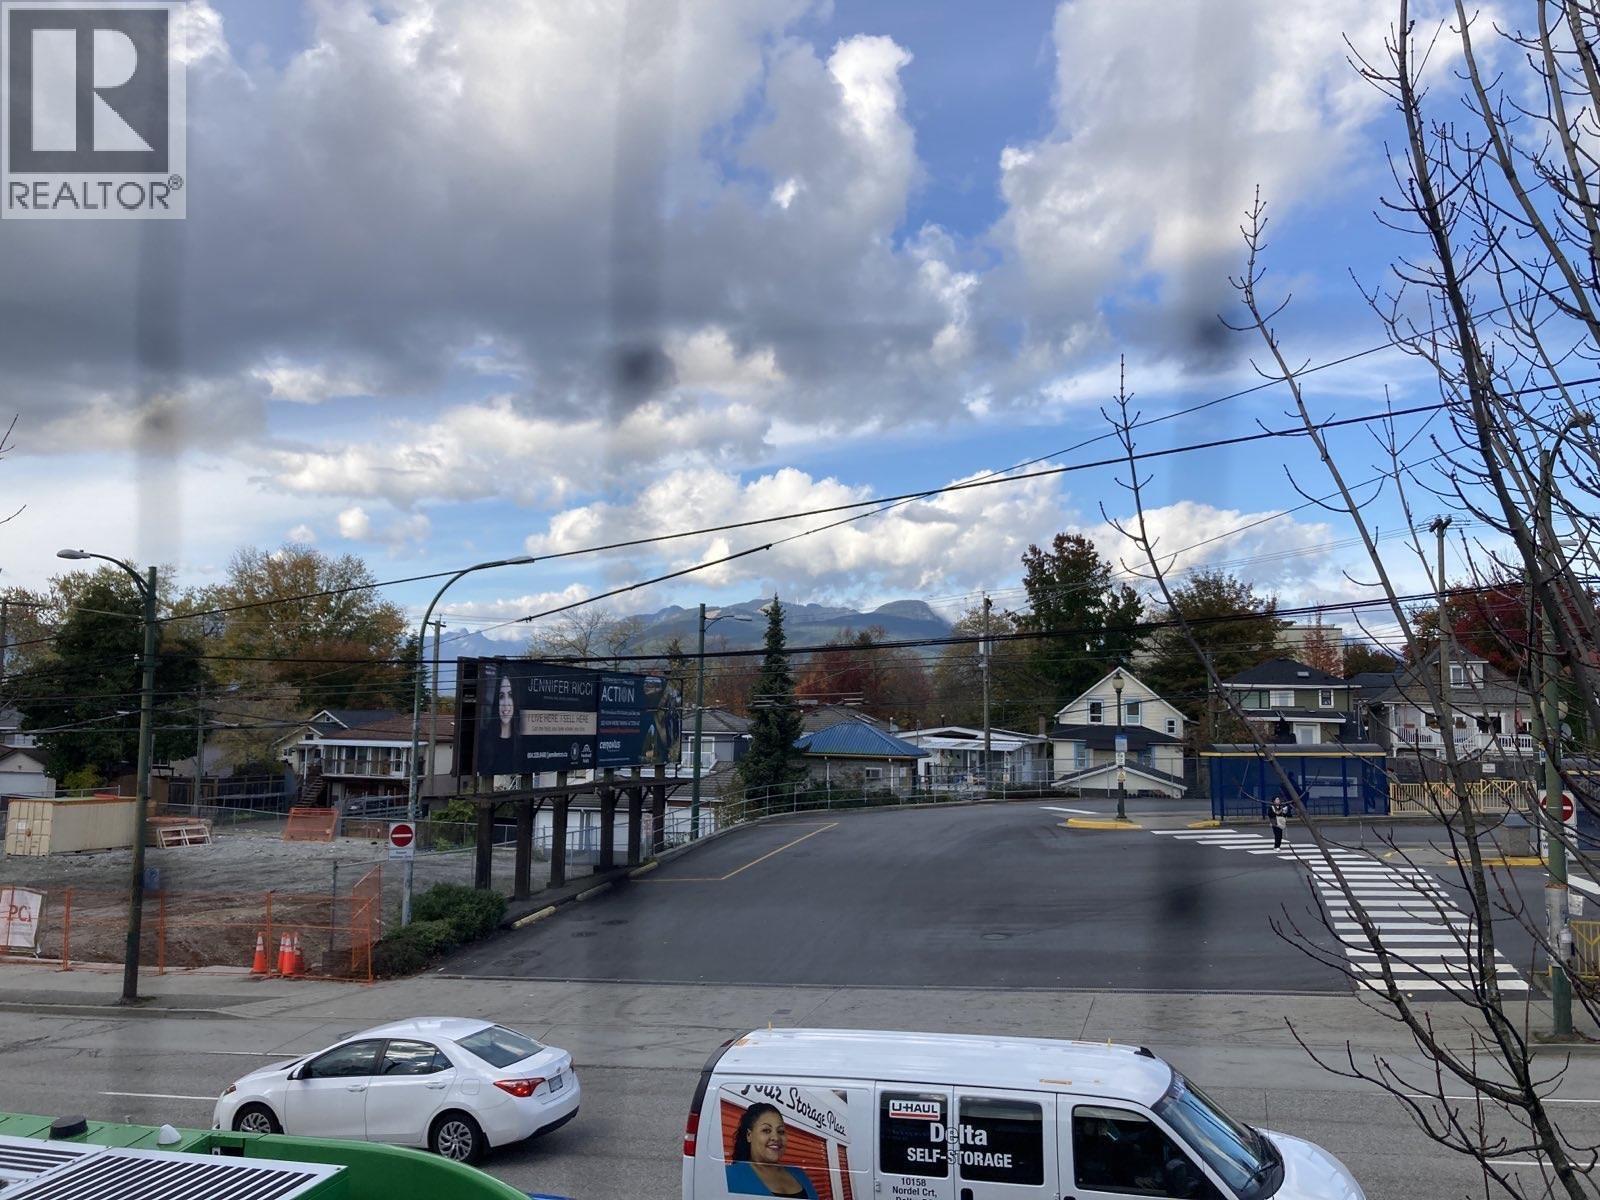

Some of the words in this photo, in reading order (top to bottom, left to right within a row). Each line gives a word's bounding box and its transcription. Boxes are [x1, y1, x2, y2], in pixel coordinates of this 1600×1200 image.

[528, 678, 569, 694] JENNIFER
[571, 681, 593, 696] RICCI
[601, 686, 635, 703] ACTION
[786, 1087, 827, 1129] Storage
[827, 1110, 847, 1136] Place
[892, 1102, 938, 1113] U-HAUL
[929, 1122, 988, 1146] Delta
[907, 1147, 1013, 1168] SELF-STORAGE
[902, 1177, 927, 1187] 10158
[892, 1186, 920, 1196] Nordel
[922, 1188, 938, 1198] Crt,
